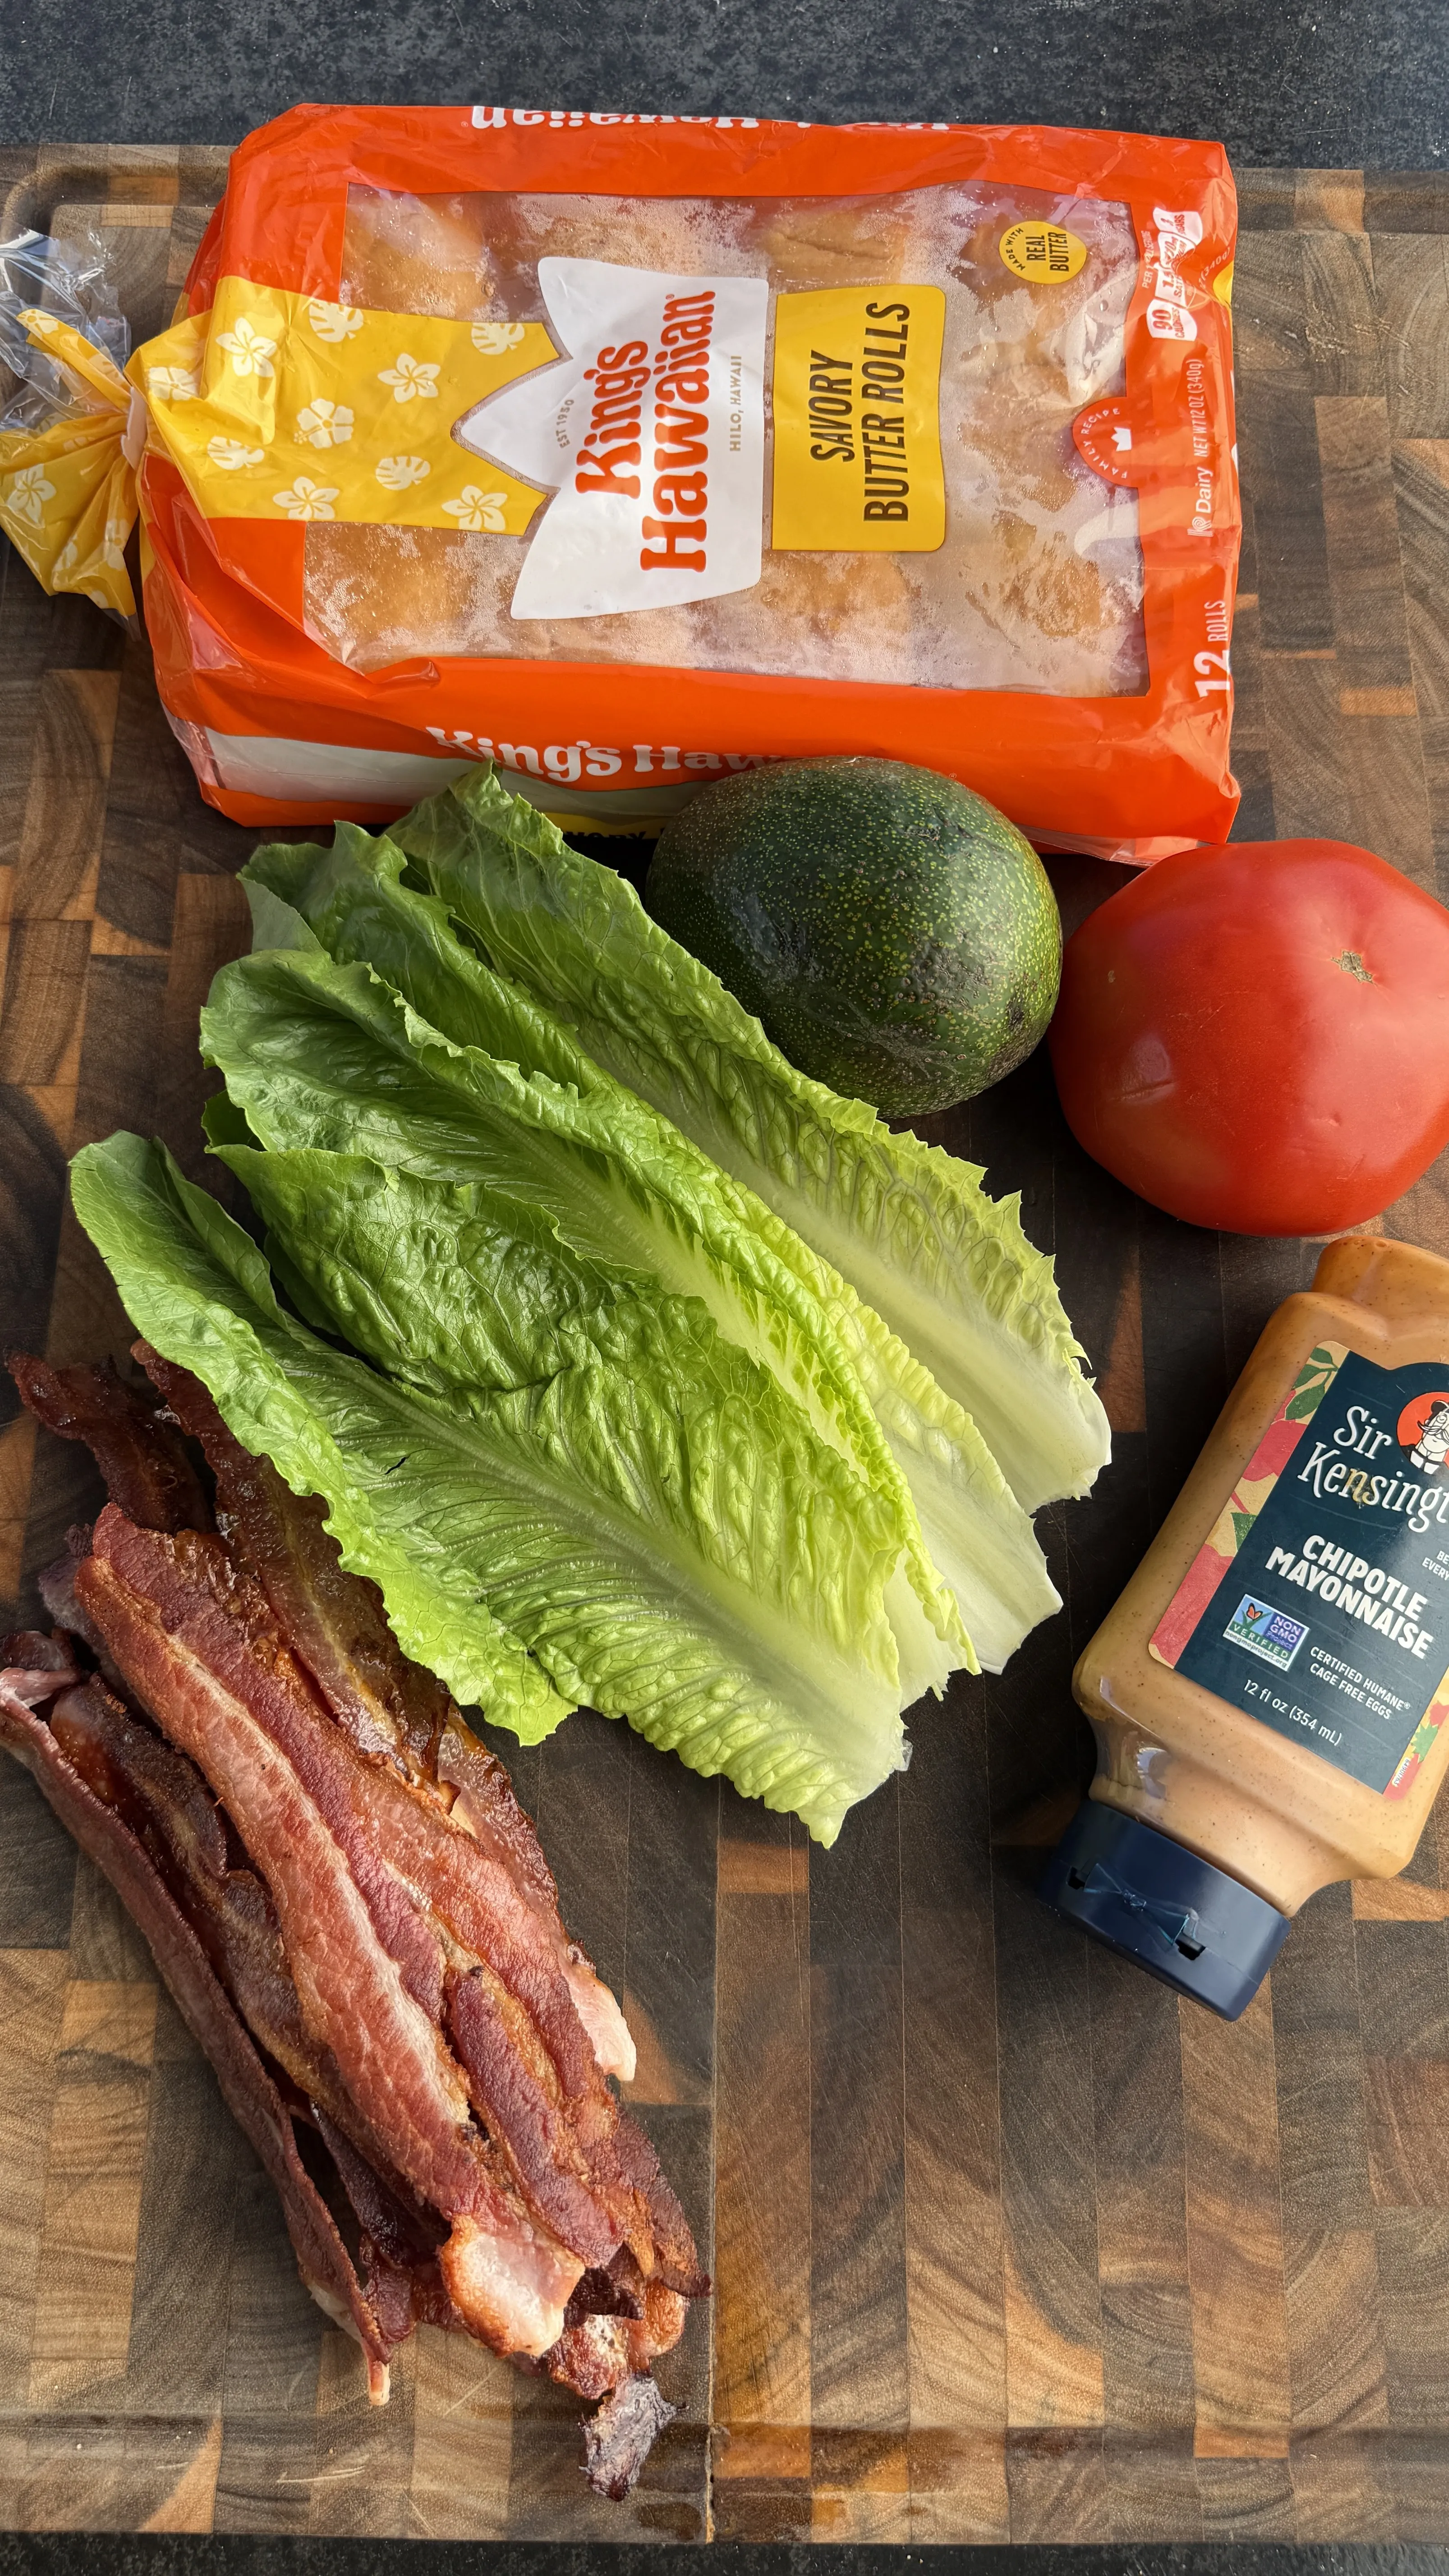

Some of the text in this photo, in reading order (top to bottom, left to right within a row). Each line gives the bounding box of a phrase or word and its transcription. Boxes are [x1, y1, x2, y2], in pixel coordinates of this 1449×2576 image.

[1005, 228, 1026, 271] MADE WITH
[1026, 235, 1046, 261] REAL
[1048, 232, 1069, 271] BUTTER
[1142, 271, 1153, 289] PER
[1151, 309, 1172, 331] 90
[556, 400, 574, 448] EST 1950
[575, 340, 651, 499] King's
[730, 355, 744, 451] HILO, HAWAII
[808, 349, 855, 463] SAVORY
[861, 302, 910, 522] BUTTER ROLLS
[1186, 359, 1208, 457] NET WT 12 OZ (340g)
[1081, 407, 1127, 478] FAMILY RECIPE
[1195, 466, 1214, 513] Dairy
[1194, 600, 1230, 697] 12 ROLLS
[1333, 1406, 1392, 1459] Sir
[1302, 1535, 1429, 1621] CHIPOTLE
[1437, 1550, 1449, 1567] BE
[1265, 1546, 1433, 1659] MAYONNAISE
[1274, 1616, 1302, 1635] NON
[1225, 1631, 1288, 1668] nongmoproject.org
[1233, 1624, 1288, 1659] VERIFIED
[1270, 1624, 1297, 1643] GMO
[1310, 1647, 1363, 1684] CERTIFIED
[1244, 1679, 1342, 1746] 12 fl oz (354 mL)
[1310, 1663, 1392, 1720] CAGE FREE EGGS
